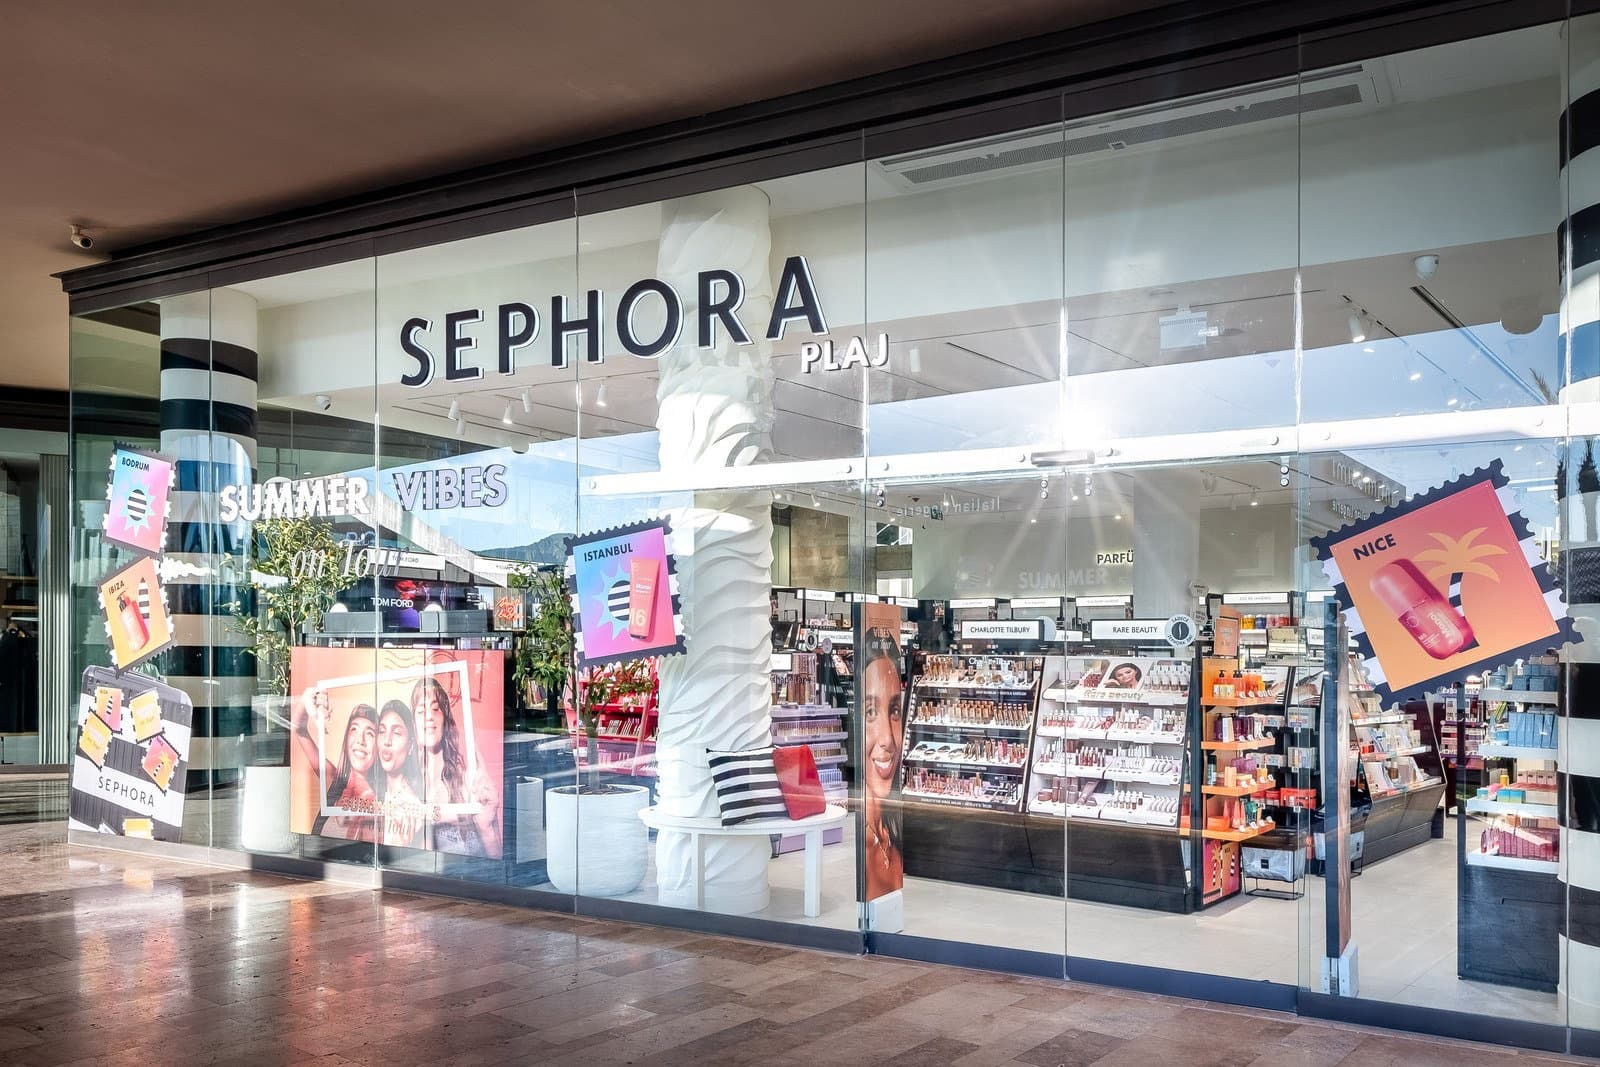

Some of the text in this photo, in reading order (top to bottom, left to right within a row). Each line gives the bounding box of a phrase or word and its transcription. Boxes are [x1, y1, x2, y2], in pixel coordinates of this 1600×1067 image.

[400, 255, 829, 388] SEPHORA
[801, 333, 890, 374] PLAJ
[121, 456, 151, 472] BODRUM
[219, 463, 509, 522] SUMMER VIBES
[583, 542, 633, 562] ISTANBUL
[1353, 533, 1397, 560] NICE
[338, 540, 410, 578] Tour
[108, 580, 125, 595] IBIZA
[390, 598, 414, 608] FORD
[631, 607, 647, 626] 16
[970, 625, 1031, 634] CHARLOTTE TILBURY
[1112, 626, 1159, 634] RARE BEAUTY
[98, 776, 154, 807] SEPHORA
